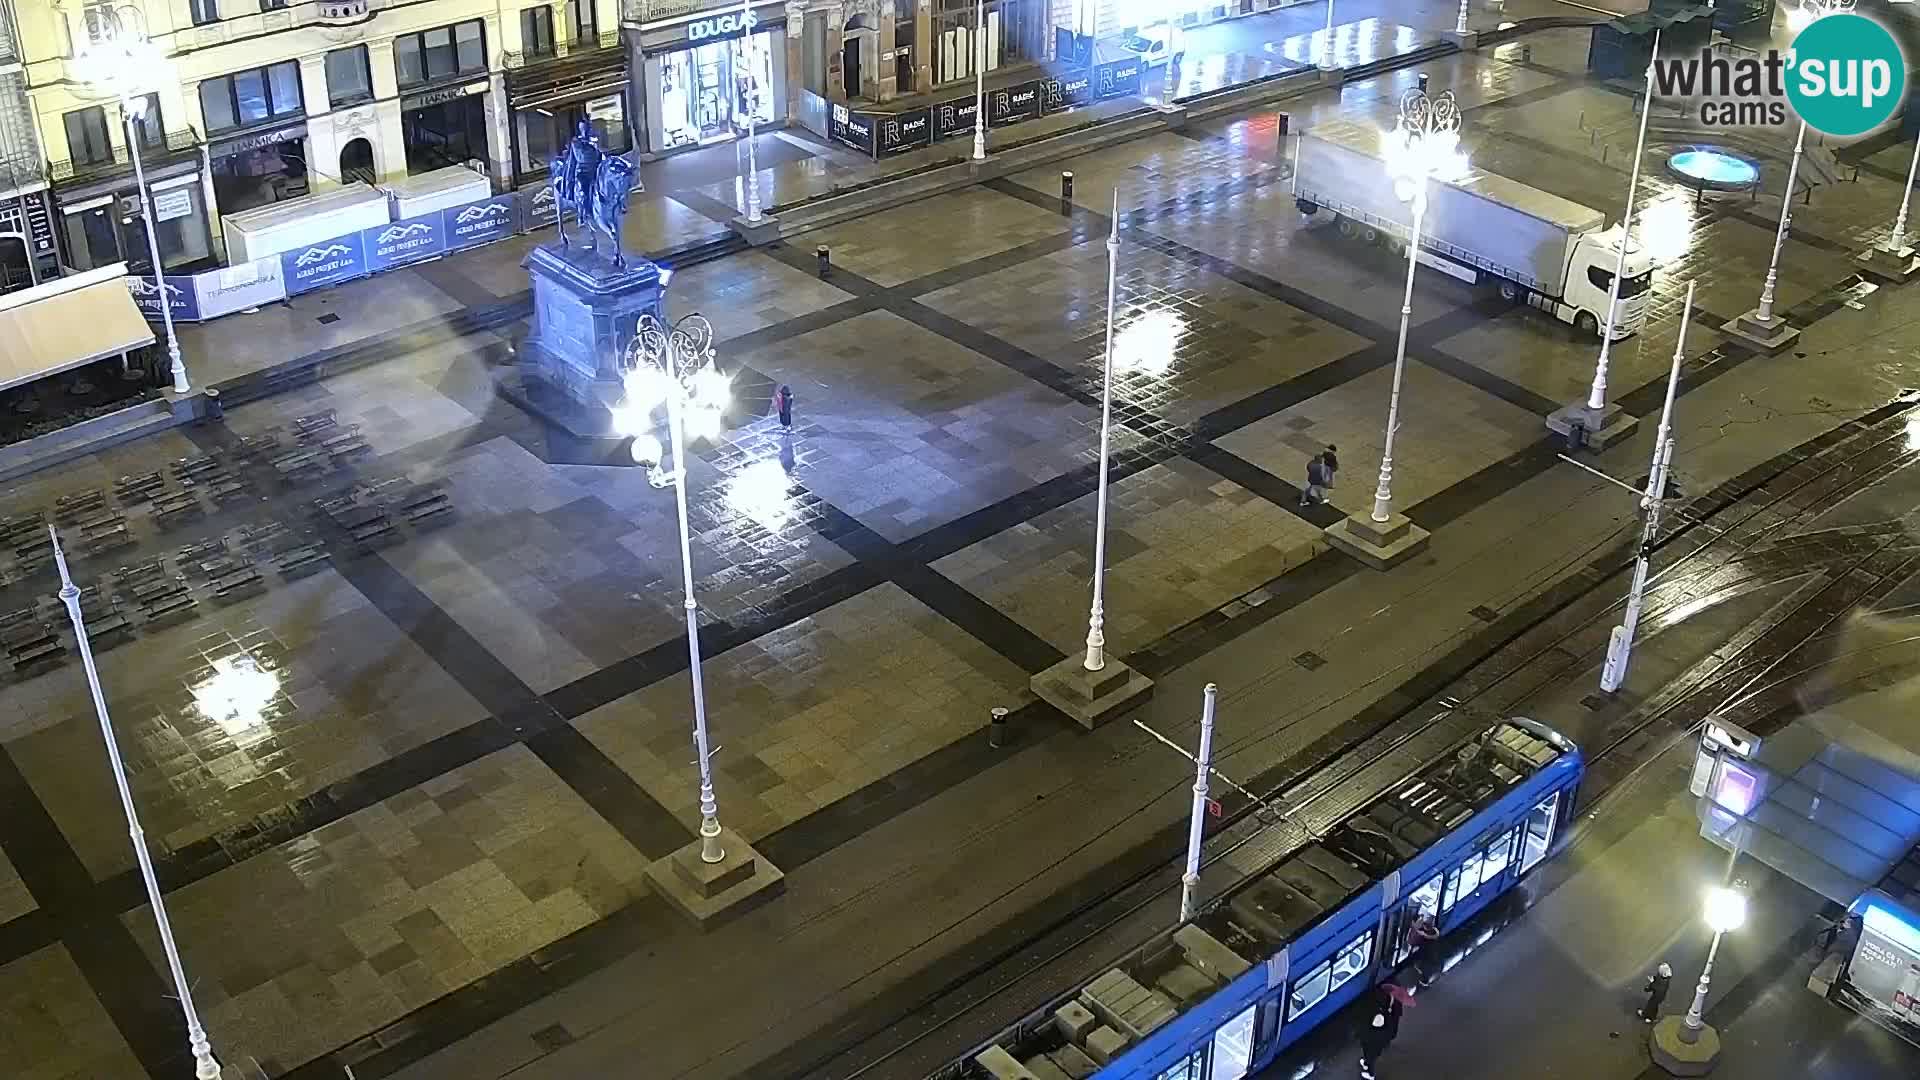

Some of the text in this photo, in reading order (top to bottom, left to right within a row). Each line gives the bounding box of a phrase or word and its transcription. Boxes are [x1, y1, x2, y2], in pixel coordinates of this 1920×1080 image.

[688, 9, 758, 41] DOUGLAS
[1048, 80, 1063, 104] R
[996, 93, 1010, 116] R
[941, 105, 955, 129] R
[884, 120, 901, 145] R
